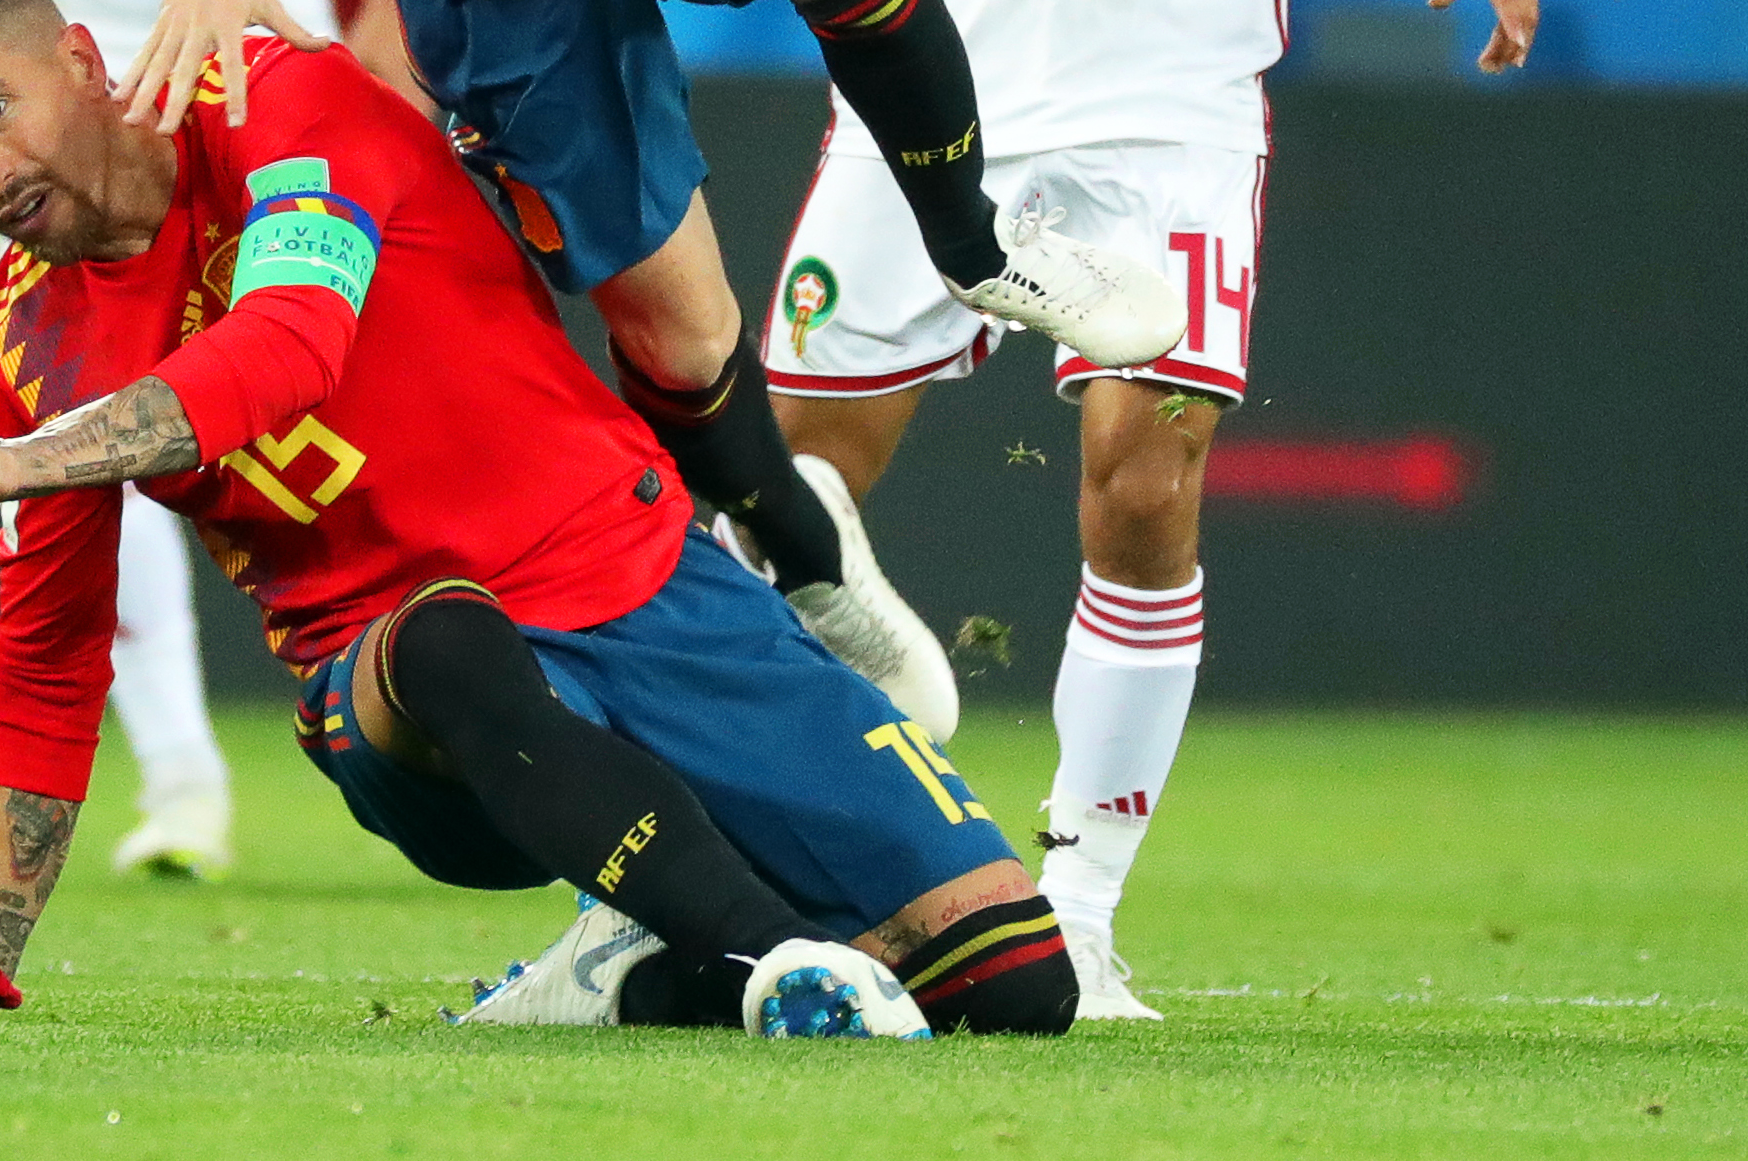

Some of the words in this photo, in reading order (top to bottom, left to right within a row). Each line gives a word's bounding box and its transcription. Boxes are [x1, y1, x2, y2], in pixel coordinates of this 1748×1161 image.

[330, 273, 360, 311] FIFA
[1168, 231, 1249, 369] 14
[219, 414, 367, 525] 15
[596, 811, 657, 894] RFEF
